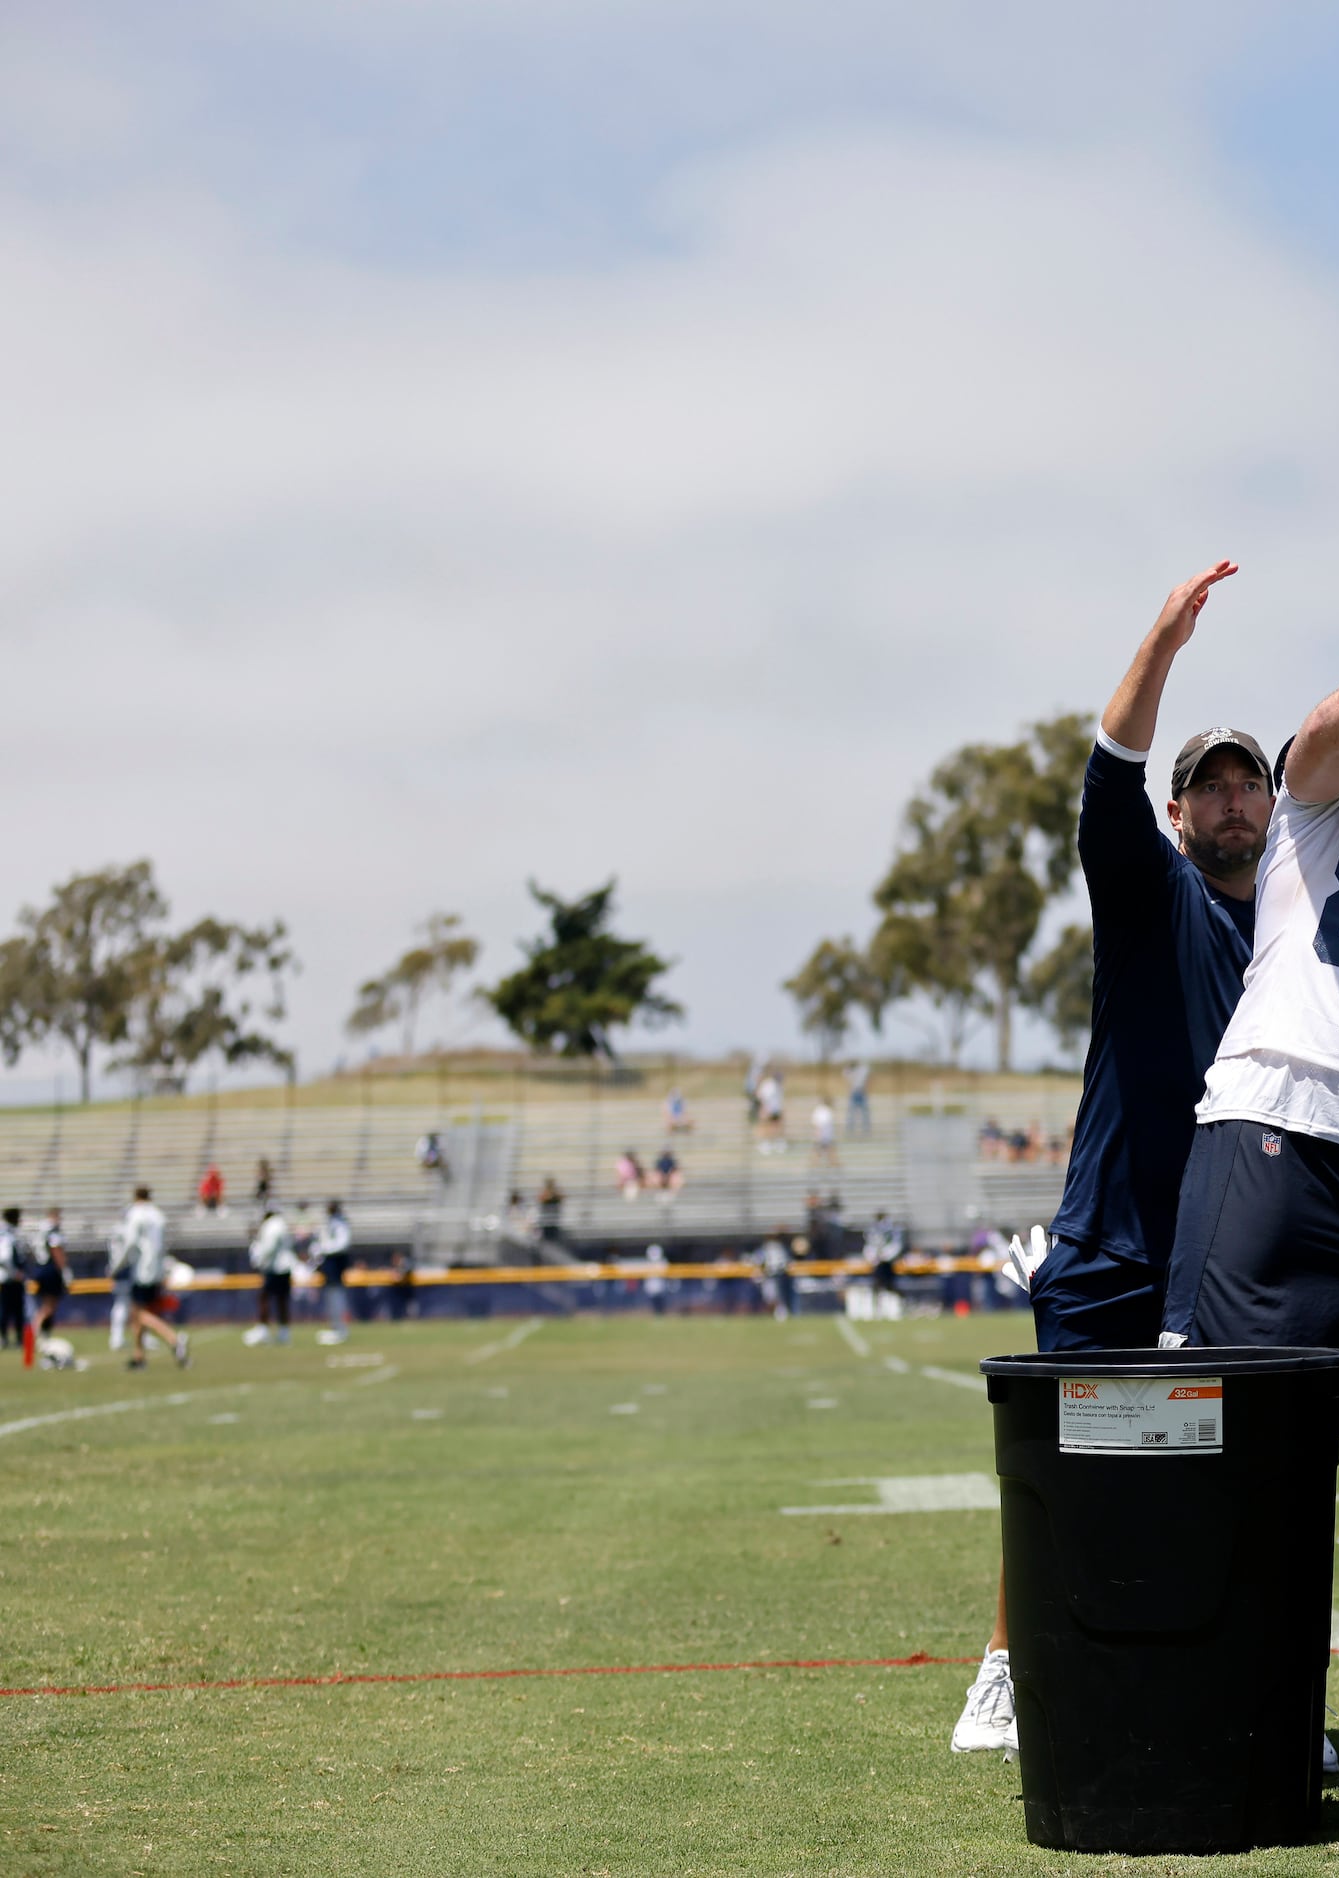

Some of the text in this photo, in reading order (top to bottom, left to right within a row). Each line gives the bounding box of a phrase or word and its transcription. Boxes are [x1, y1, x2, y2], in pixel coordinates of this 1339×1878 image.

[1264, 1142, 1279, 1153] NFL
[1063, 1382, 1099, 1399] HDX
[1174, 1388, 1199, 1398] 32 Gal
[1078, 1403, 1105, 1411] Container
